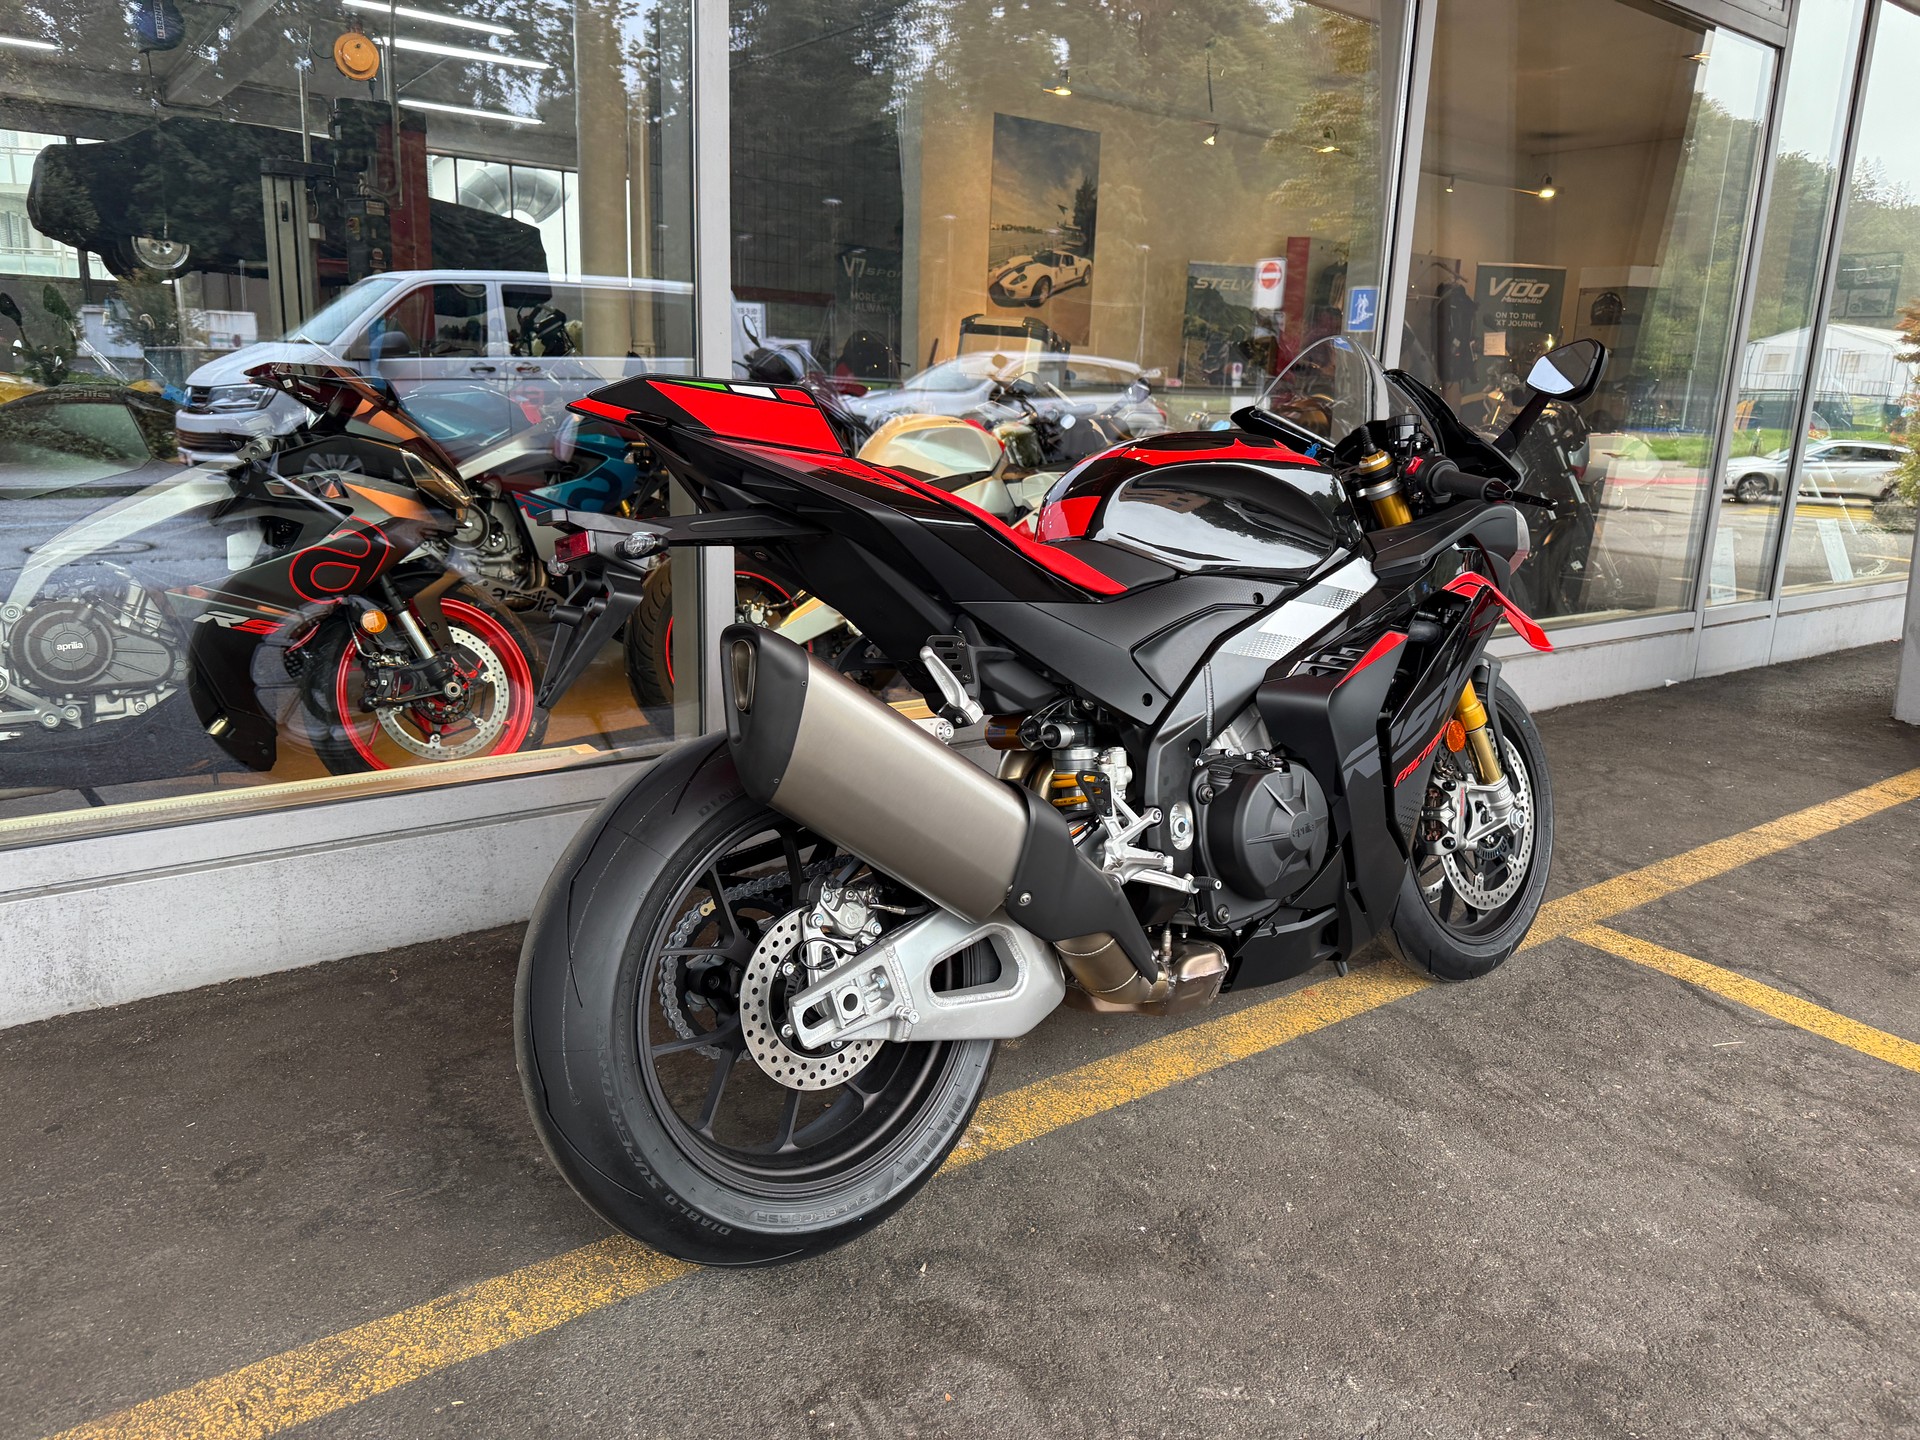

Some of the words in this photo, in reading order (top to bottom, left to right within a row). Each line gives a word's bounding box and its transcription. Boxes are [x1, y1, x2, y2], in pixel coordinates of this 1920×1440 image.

[842, 256, 866, 278] V7
[1194, 277, 1254, 291] STELV
[1489, 277, 1550, 298] V100
[56, 641, 84, 652] aprilia
